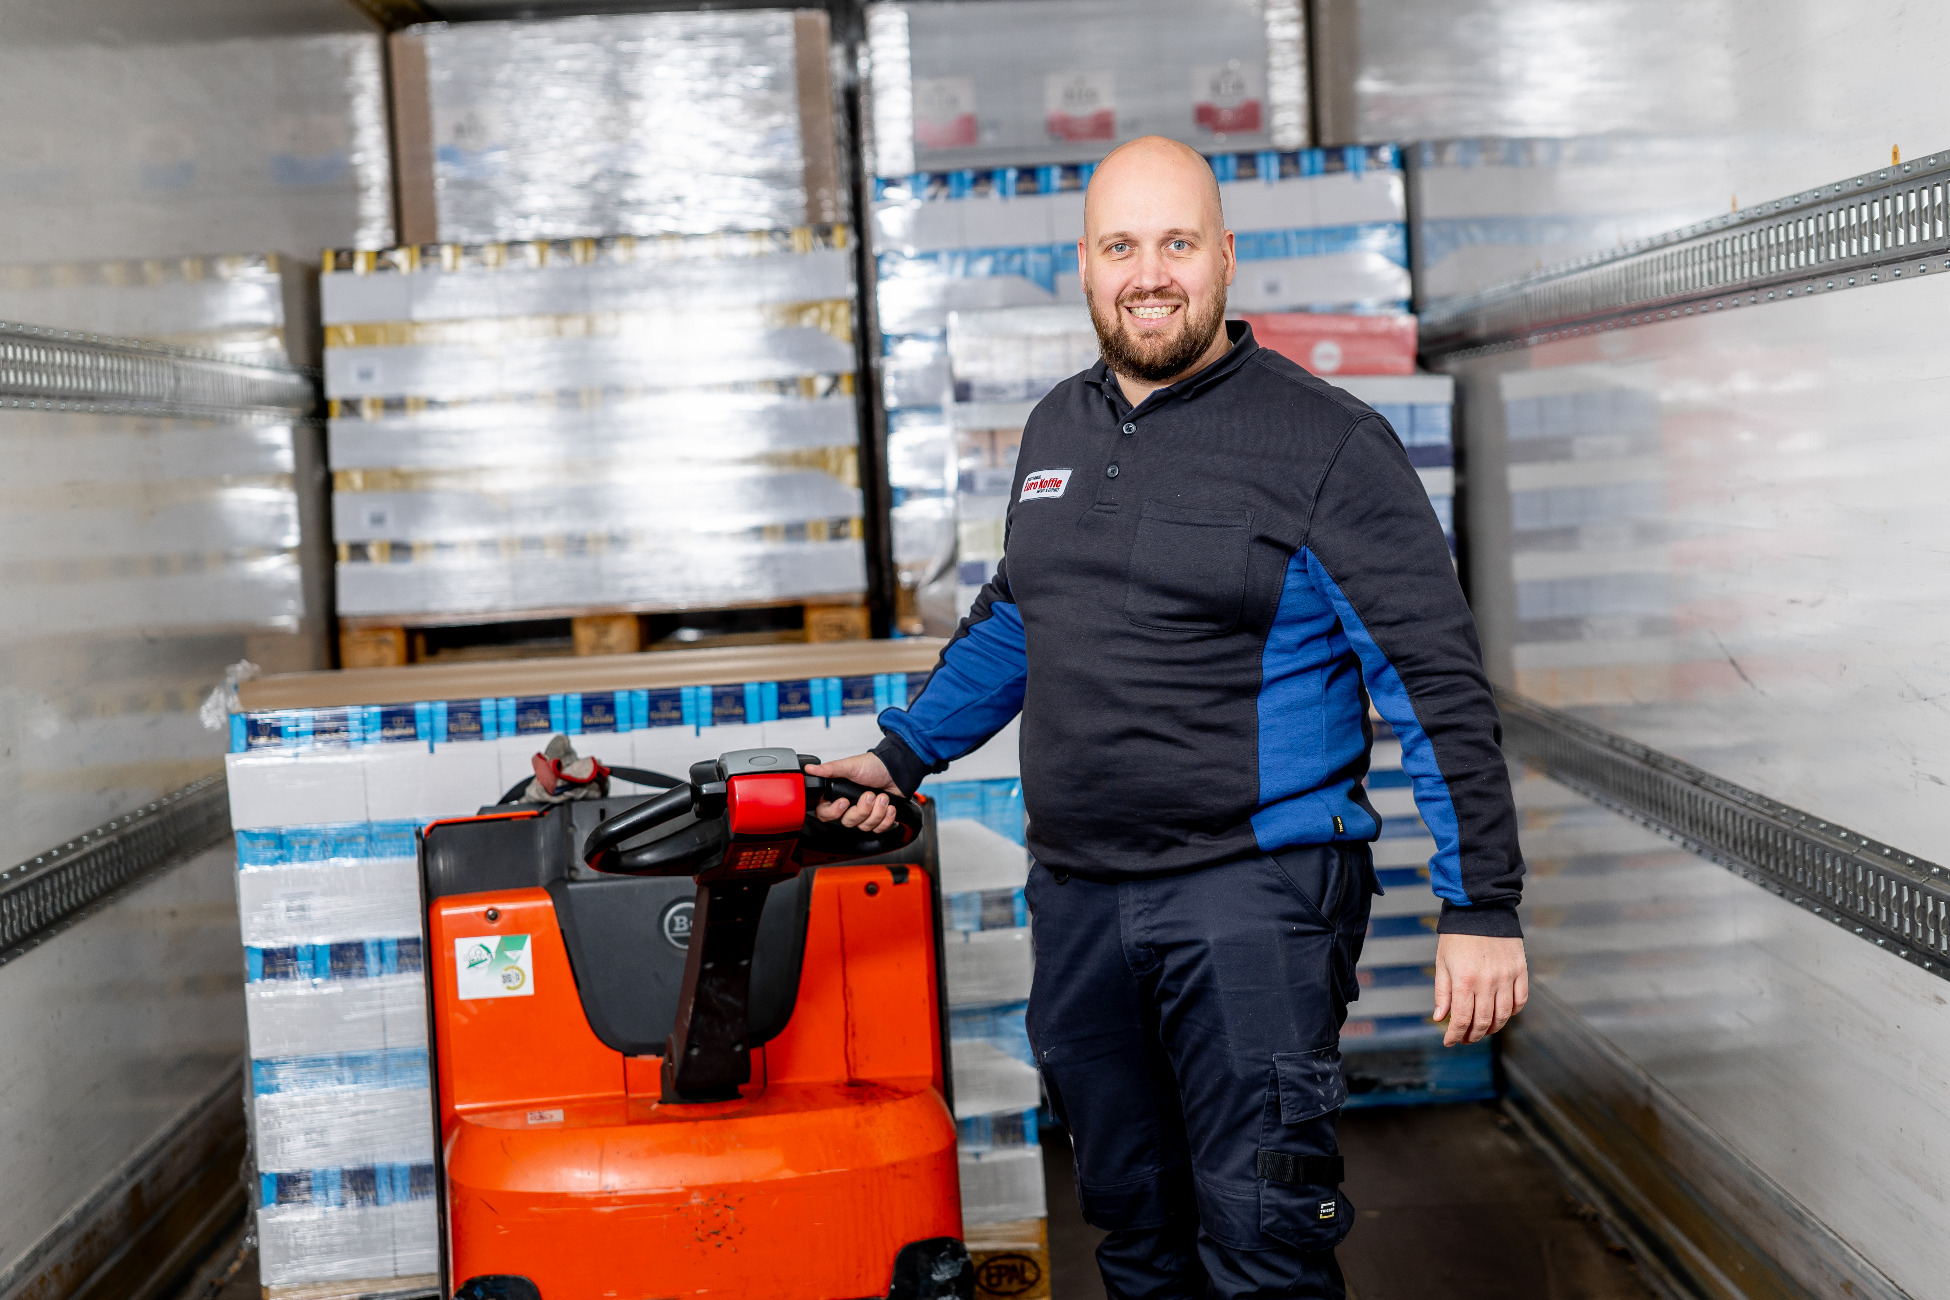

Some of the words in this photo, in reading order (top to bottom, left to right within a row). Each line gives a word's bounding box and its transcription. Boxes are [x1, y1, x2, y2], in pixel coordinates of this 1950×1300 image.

[1024, 480, 1039, 492] Euro
[1039, 478, 1062, 489] Koffie
[673, 915, 693, 932] B
[987, 1263, 1030, 1288] EPAL
